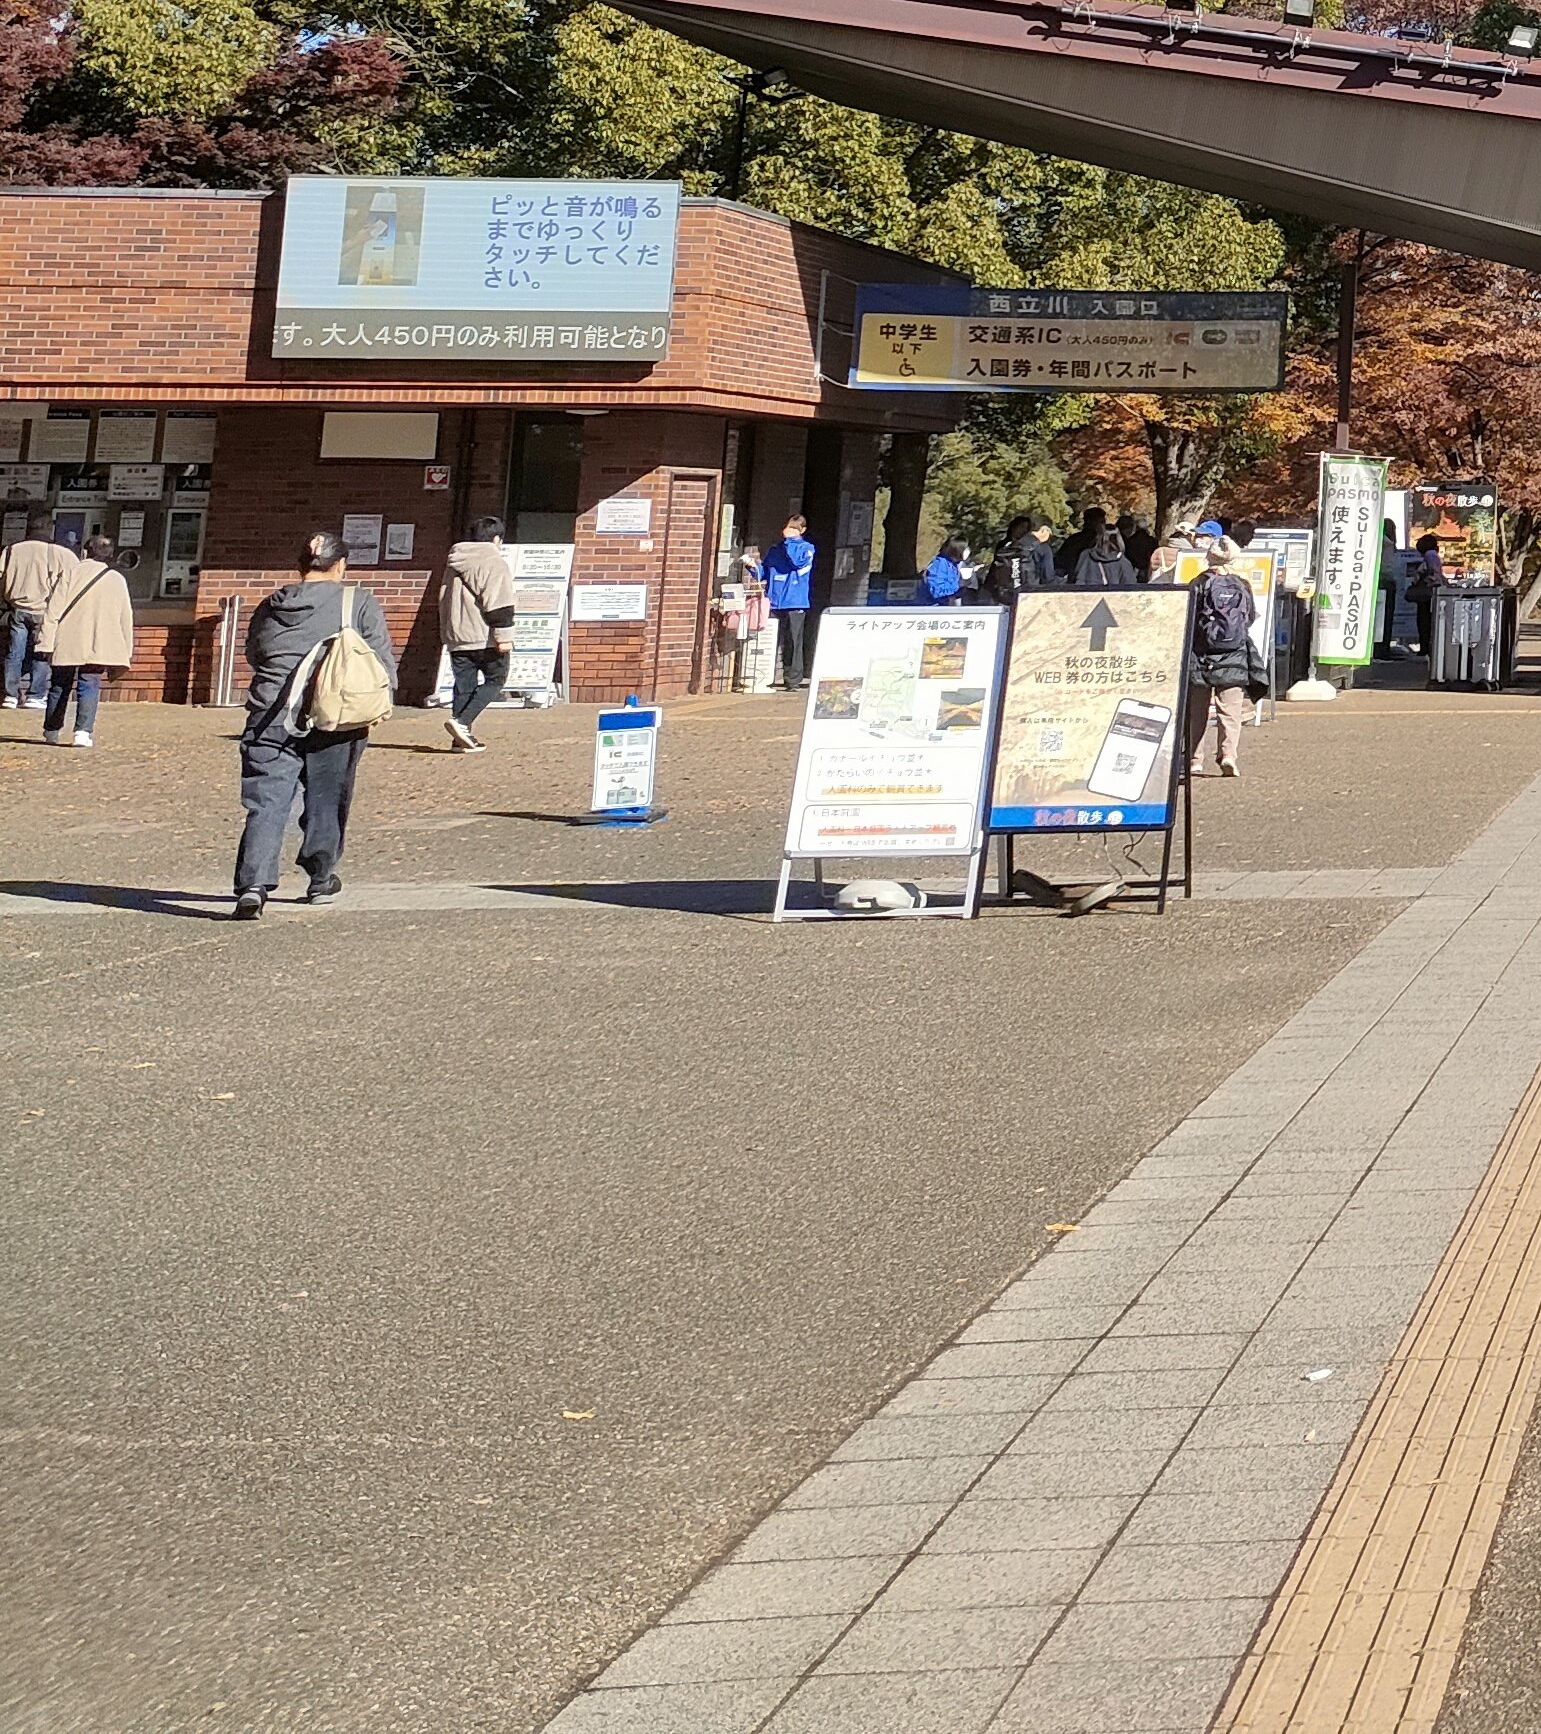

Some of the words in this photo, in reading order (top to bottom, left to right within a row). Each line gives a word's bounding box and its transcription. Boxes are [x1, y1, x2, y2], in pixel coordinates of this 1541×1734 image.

[491, 195, 663, 219] ピッと音が鳴る
[487, 220, 634, 241] までゆっくり
[483, 243, 660, 267] タッチしてくだ
[483, 267, 542, 290] さい。
[987, 294, 1069, 315] 西立川
[1091, 299, 1159, 316] 入園口
[879, 323, 938, 342] 中学生
[968, 325, 1062, 345] 交通系IC
[892, 343, 922, 356] 以下
[966, 358, 1198, 380] 入園券・年間パスポート
[1329, 472, 1380, 487] Suica
[1327, 487, 1380, 502] PASMO
[1325, 505, 1350, 590] 使えます。
[846, 619, 986, 631] ライトアップ会場のご案内
[1065, 655, 1138, 670] 秋の夜散歩
[1034, 671, 1062, 684] WEB
[1066, 669, 1168, 685] 券の方はこちら
